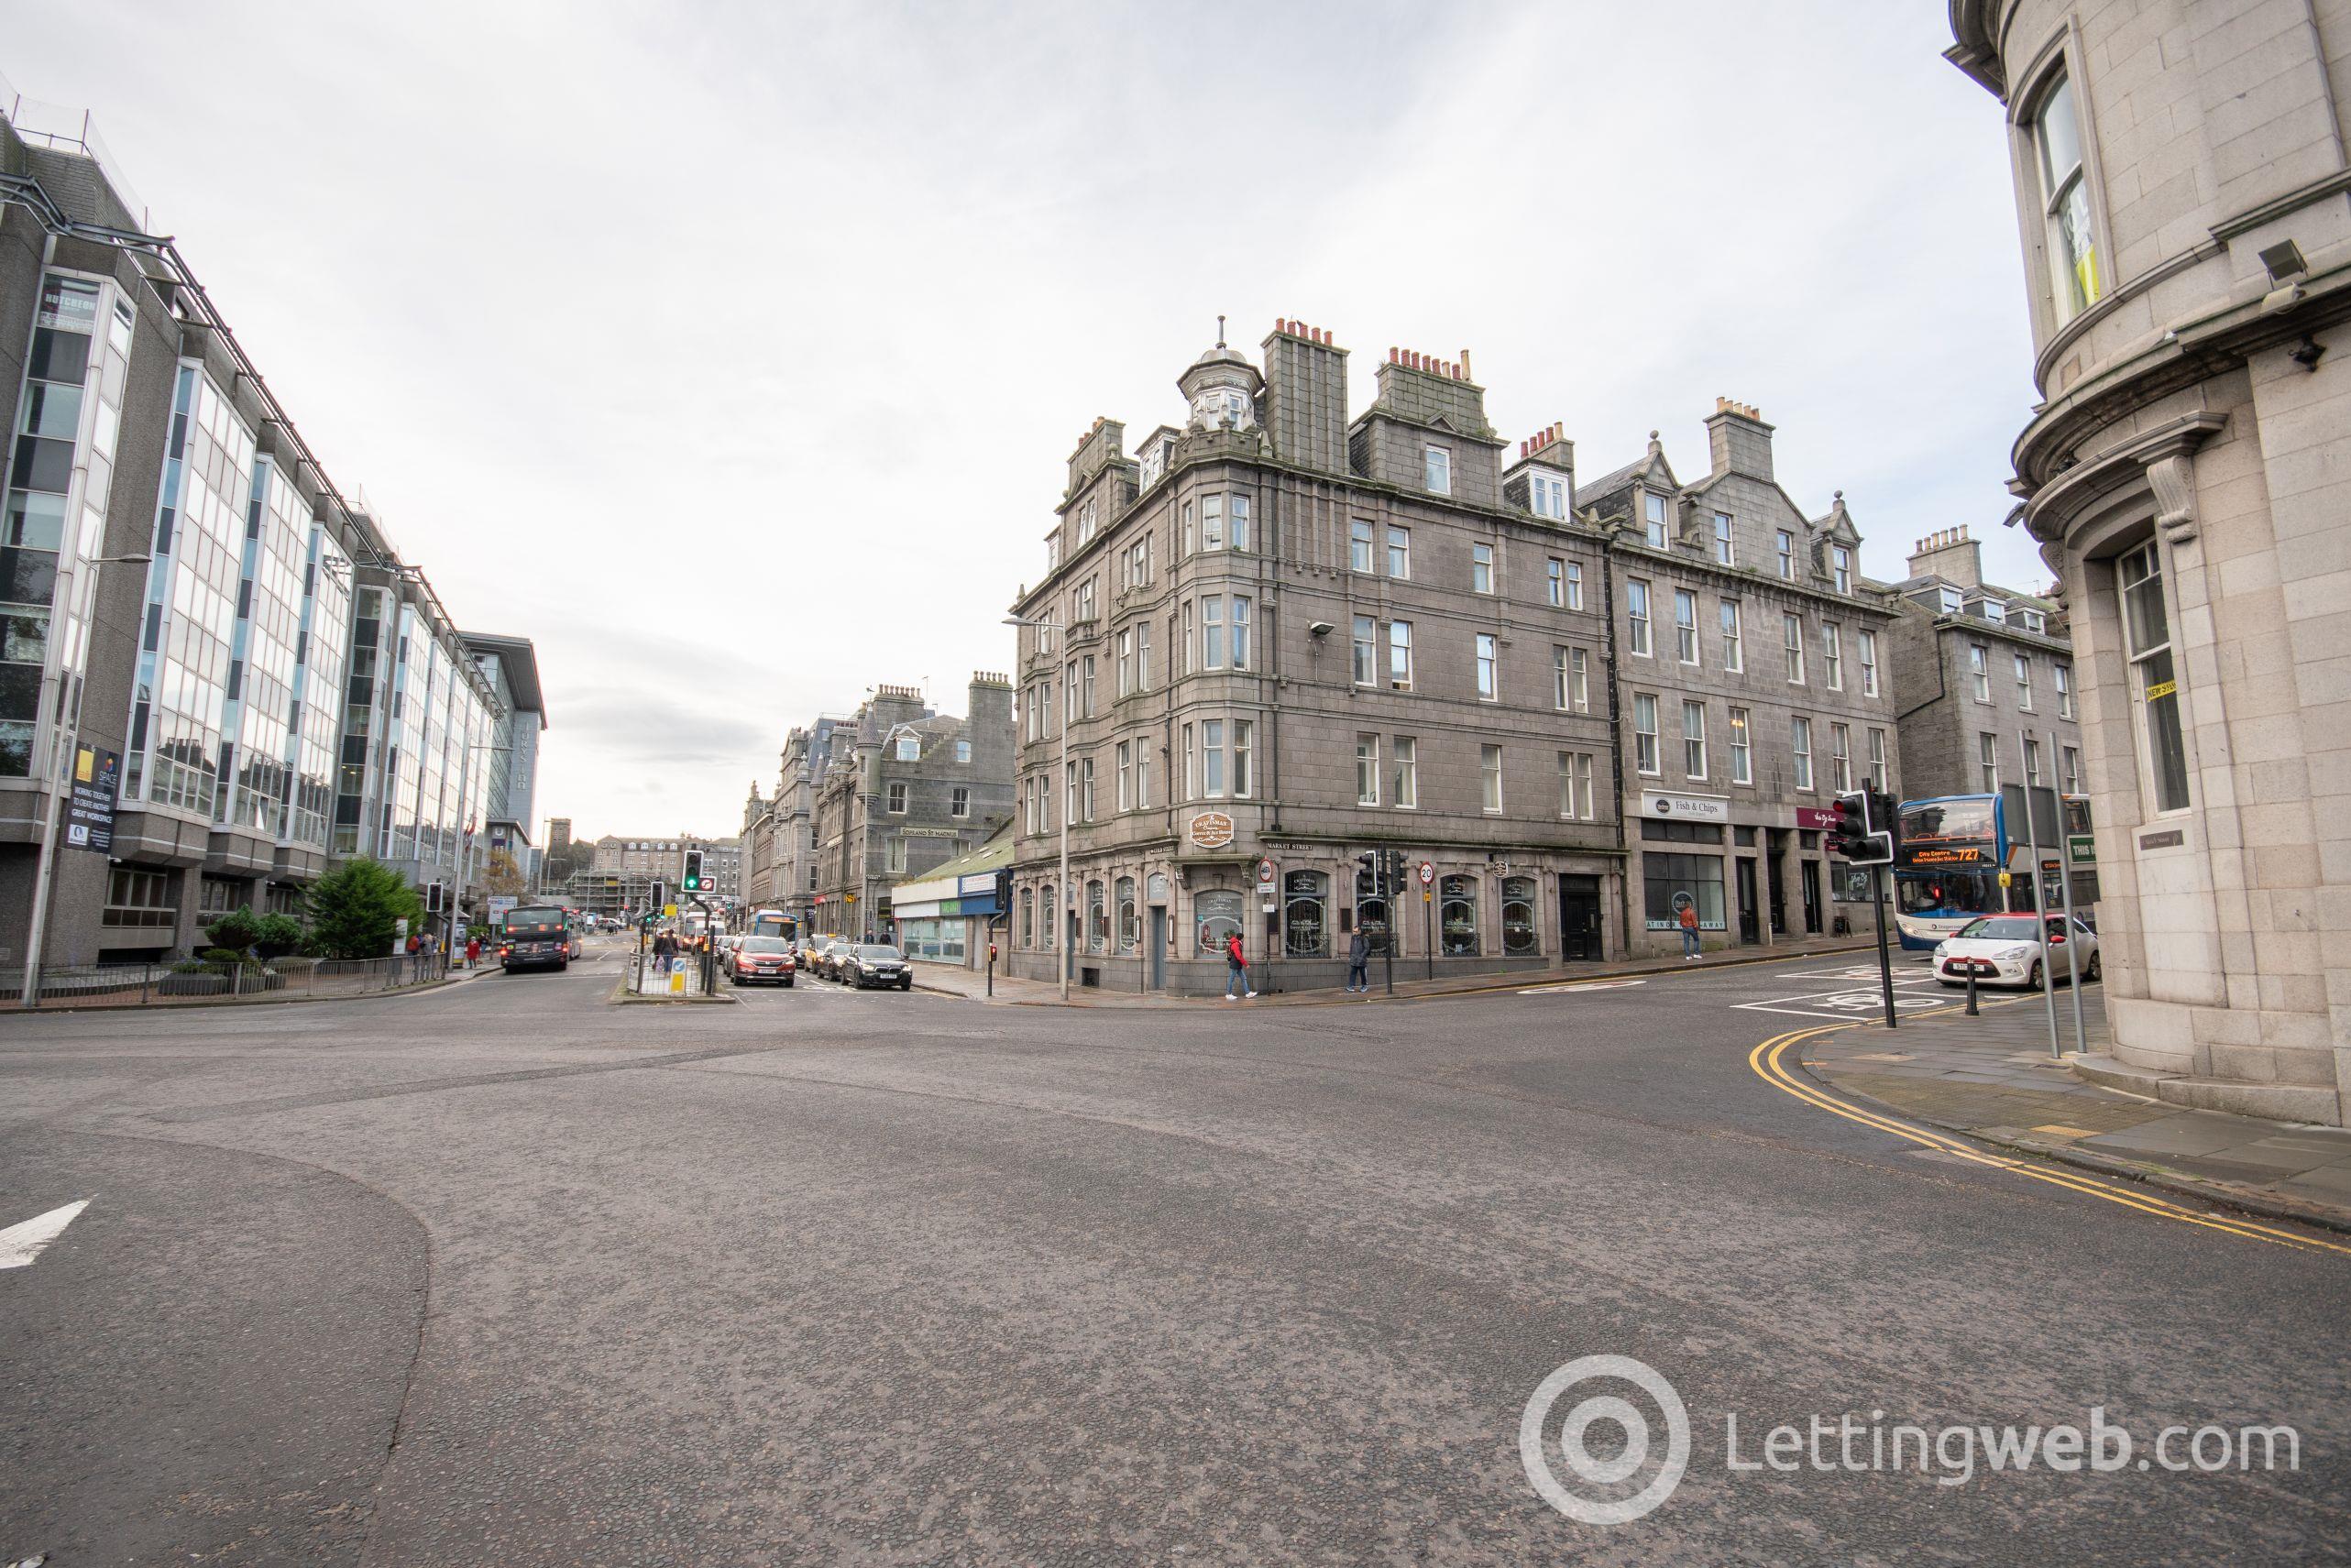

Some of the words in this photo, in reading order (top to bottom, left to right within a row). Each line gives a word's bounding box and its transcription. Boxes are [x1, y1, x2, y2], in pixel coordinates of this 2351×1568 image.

[2148, 687, 2161, 699] NEW
[99, 771, 117, 784] SPACE
[1675, 800, 1690, 811] Fish
[1691, 803, 1697, 811] &
[1698, 803, 1719, 815] Chips
[87, 812, 112, 824] WORKSPACE
[1957, 849, 1979, 861] 727
[2072, 845, 2090, 855] THIS
[1422, 869, 1431, 877] 20
